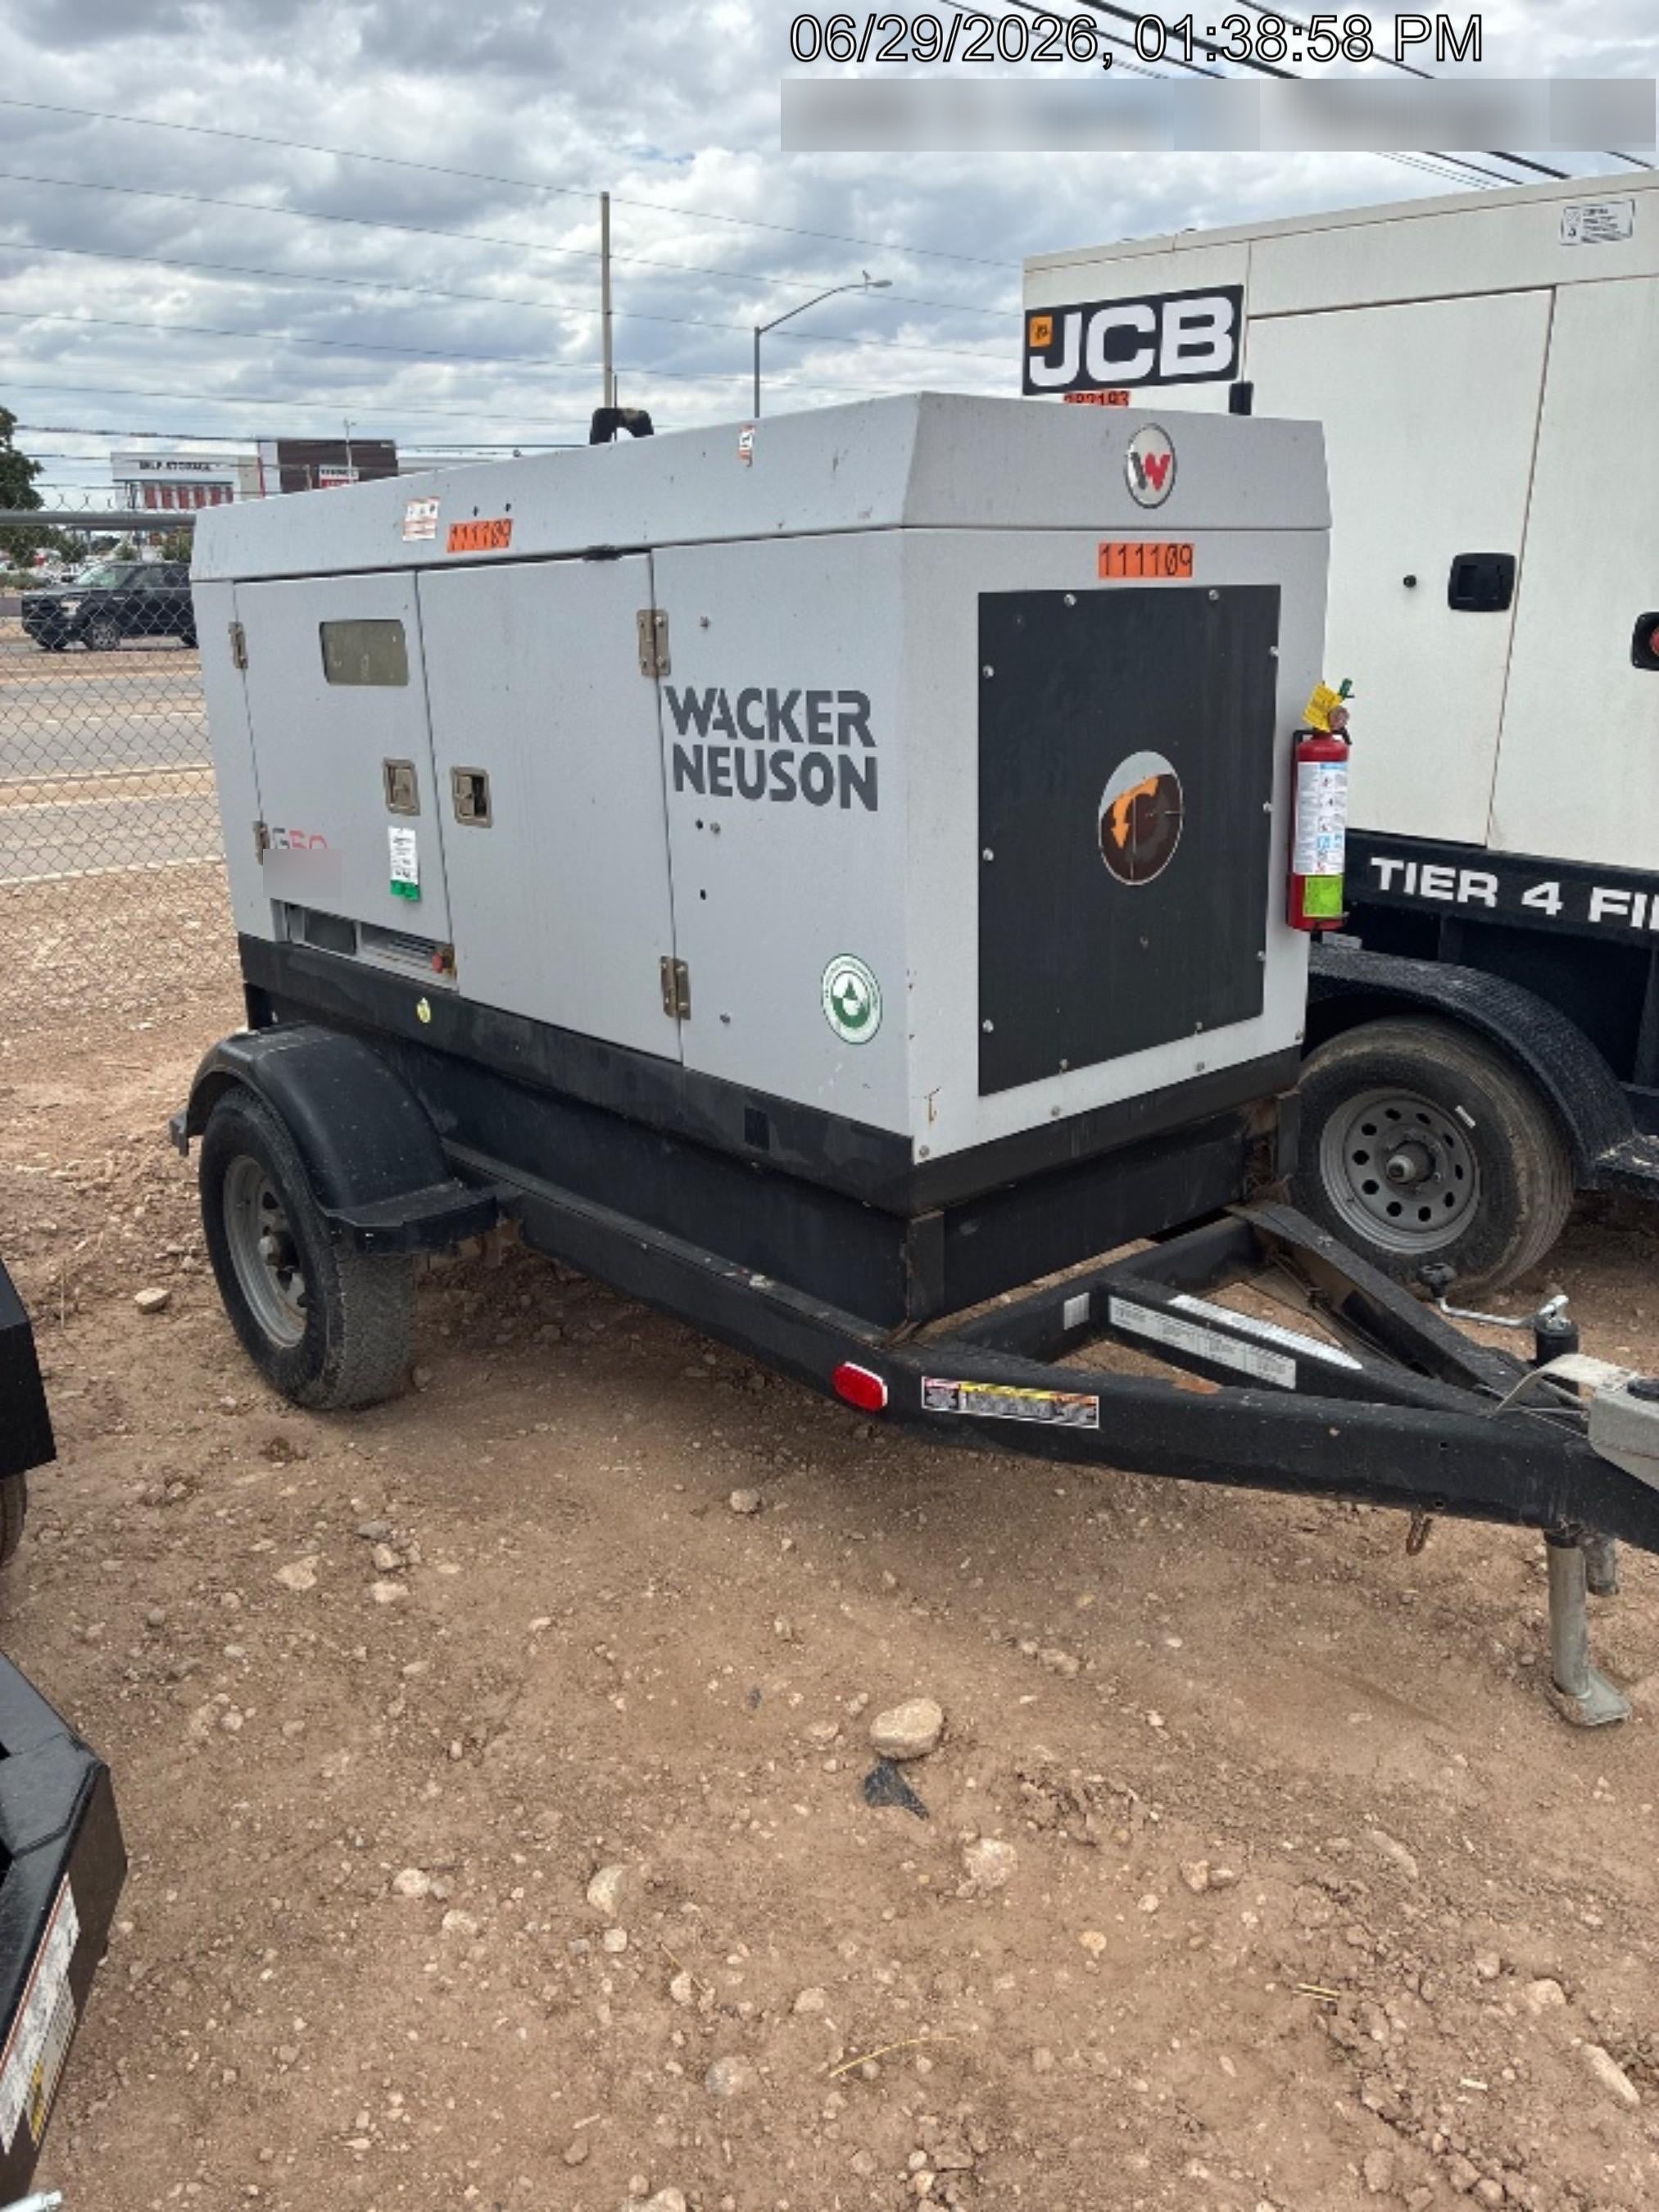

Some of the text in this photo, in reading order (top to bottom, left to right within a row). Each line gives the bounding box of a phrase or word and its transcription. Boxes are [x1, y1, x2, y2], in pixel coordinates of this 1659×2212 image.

[1029, 297, 1234, 387] JCB
[1100, 544, 1193, 576] 111109
[664, 685, 878, 747] WACKER
[673, 742, 878, 811] NEUSON
[1370, 857, 1498, 908] TIER
[1521, 882, 1563, 915] 4
[1588, 887, 1659, 930] FI
